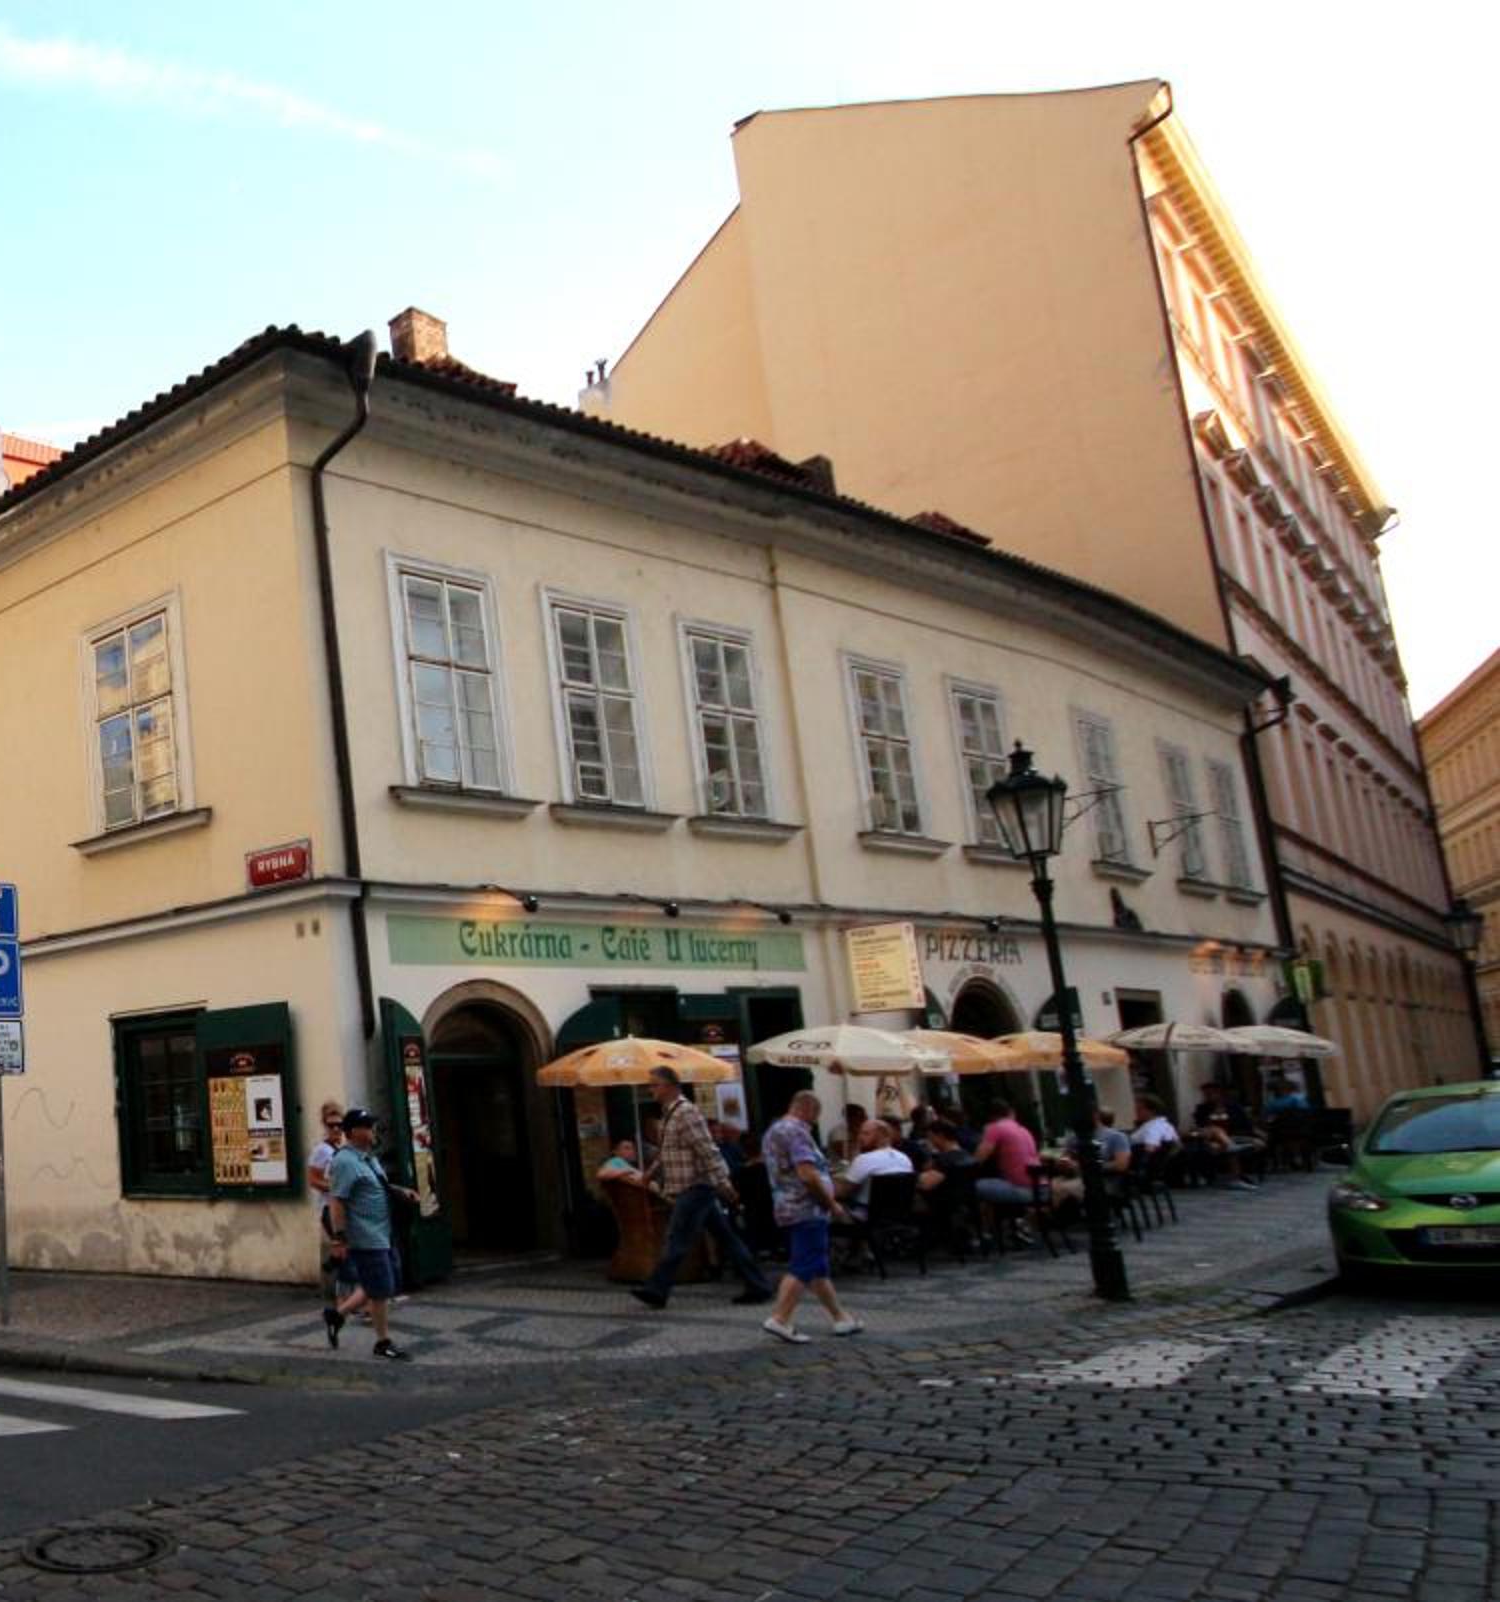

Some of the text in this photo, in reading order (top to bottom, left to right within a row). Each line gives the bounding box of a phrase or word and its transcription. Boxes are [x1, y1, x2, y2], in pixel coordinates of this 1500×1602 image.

[457, 921, 573, 960] Cukrárna
[663, 928, 682, 962] U
[691, 932, 757, 970] lucerny
[926, 932, 1023, 964] PIZZERIA
